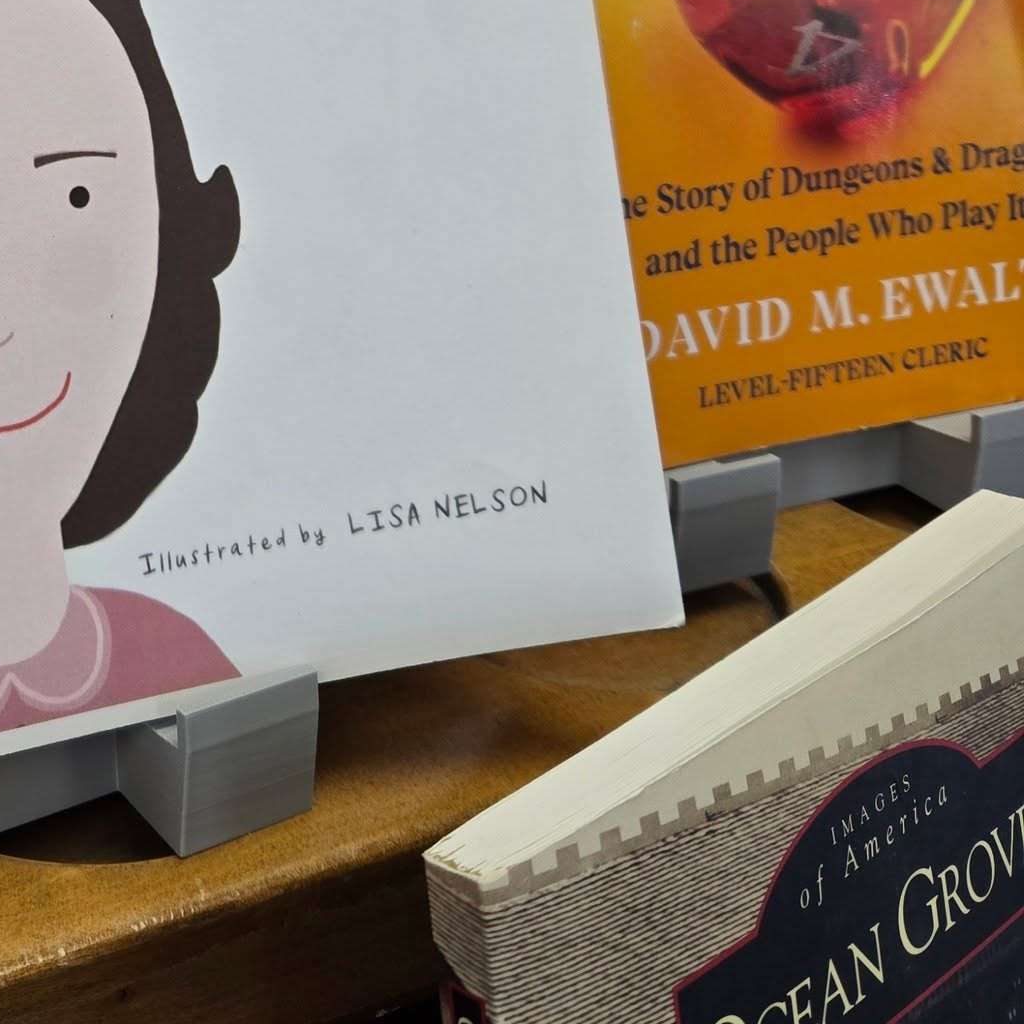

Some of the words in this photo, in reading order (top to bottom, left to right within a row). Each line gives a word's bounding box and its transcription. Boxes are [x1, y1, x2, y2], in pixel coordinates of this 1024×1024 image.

[657, 182, 734, 215] Story
[743, 168, 774, 201] of
[780, 155, 924, 196] Dungeons
[931, 146, 953, 175] &
[645, 238, 702, 276] and
[711, 234, 758, 266] the
[766, 218, 860, 256] People
[868, 207, 934, 240] Who
[940, 199, 1000, 231] Play
[640, 296, 792, 363] DAVID
[808, 285, 870, 334] M.
[879, 259, 1024, 322] EWAL
[697, 352, 897, 409] LEVEL-FIFTEEN
[901, 336, 990, 371] CLERIC
[138, 527, 287, 576] Illustrated
[299, 523, 327, 546] by
[346, 501, 422, 535] LISA
[433, 480, 548, 519] NELSON
[799, 862, 825, 909] of
[842, 784, 949, 879] America
[830, 773, 913, 846] IMAGES
[714, 920, 887, 1024] EAN
[897, 804, 1024, 956] GROV
